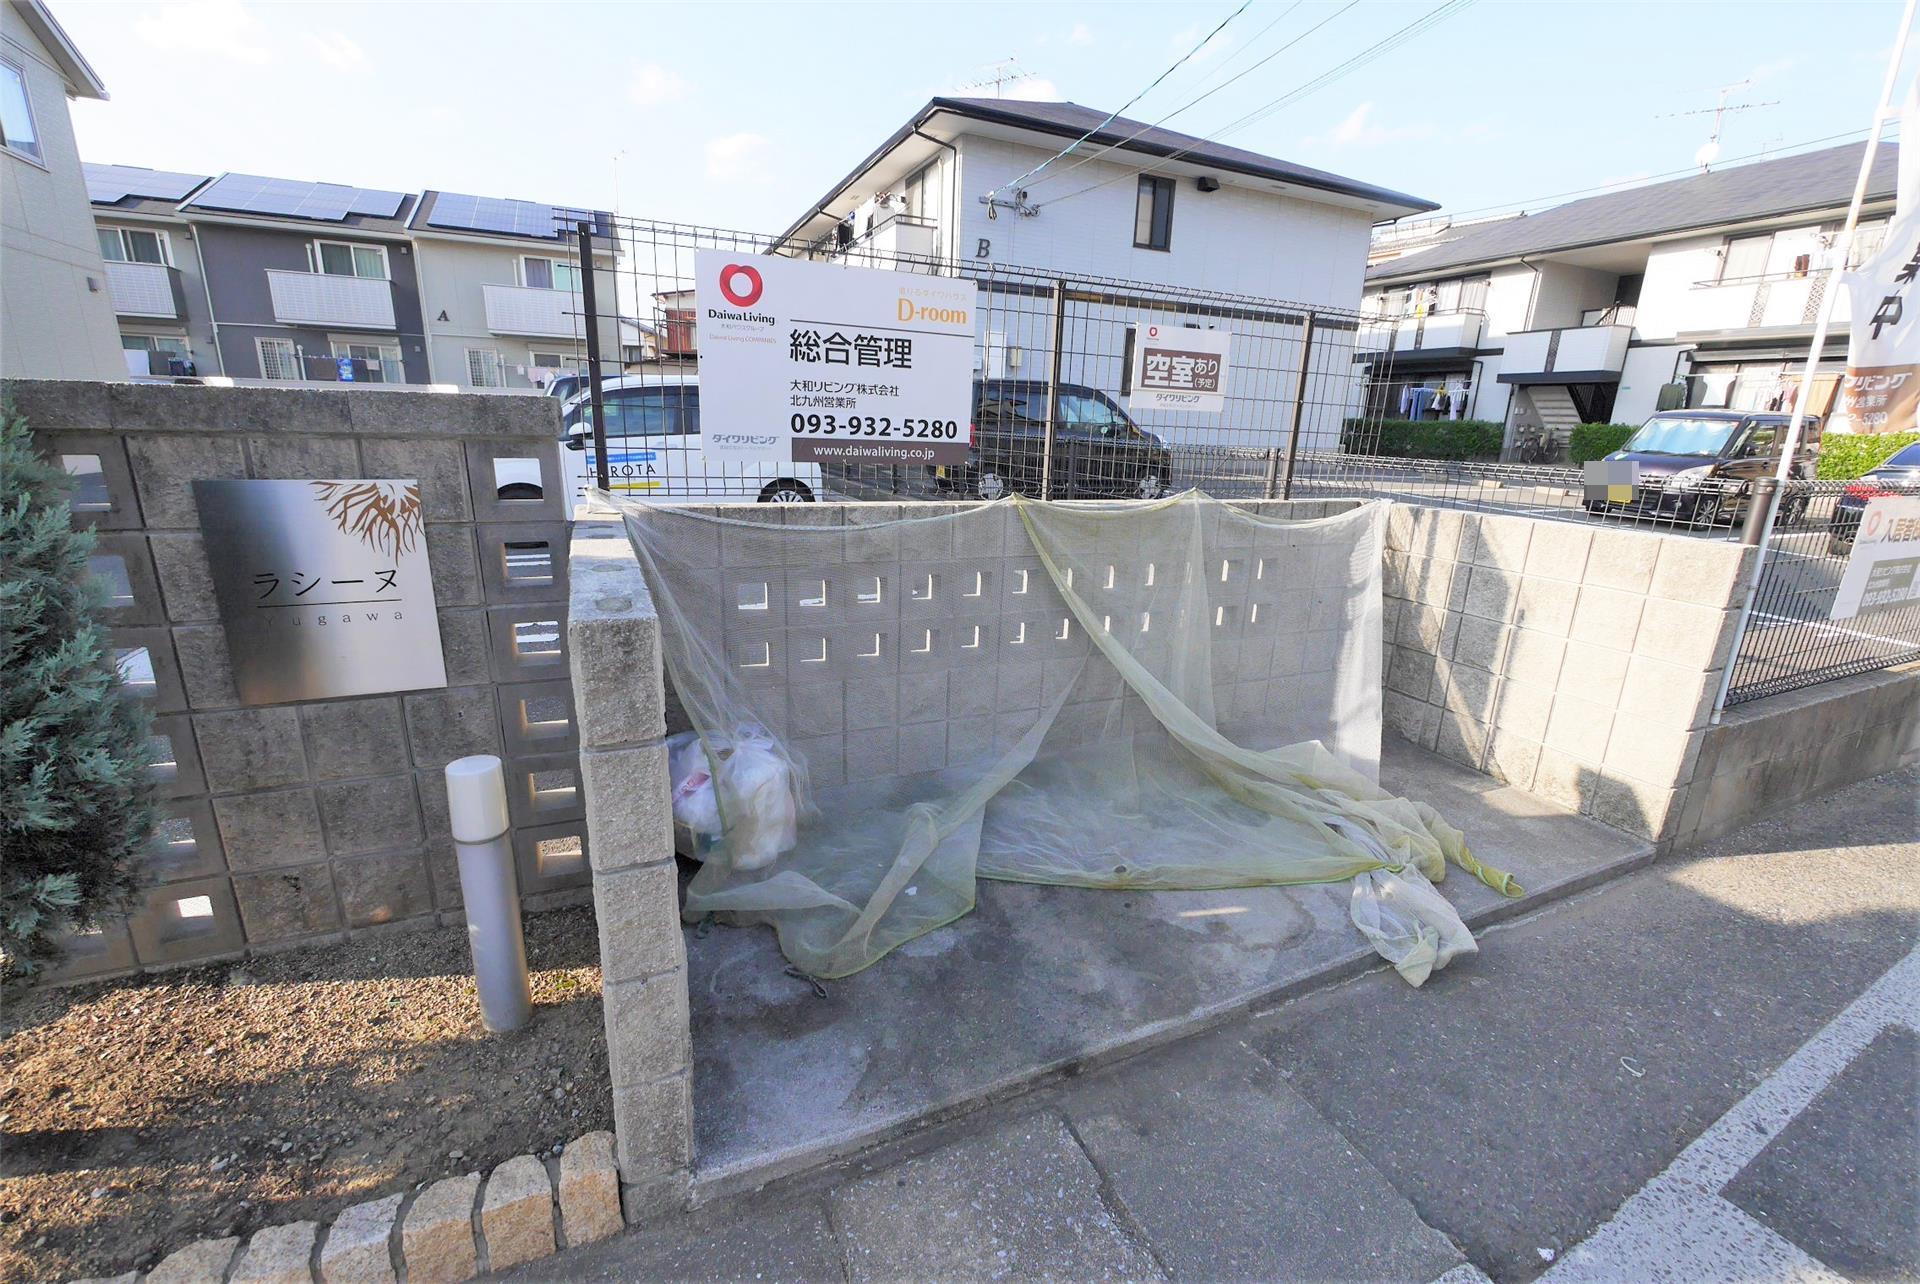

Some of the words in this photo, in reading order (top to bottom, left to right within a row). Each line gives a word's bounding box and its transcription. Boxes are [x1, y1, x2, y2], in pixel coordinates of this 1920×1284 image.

[975, 238, 991, 258] B
[437, 309, 450, 322] A
[897, 297, 967, 325] D-room
[789, 328, 912, 369] 総合管理
[790, 379, 900, 397] 大和リビング株式会社
[790, 396, 857, 409] 北九州営業所
[1155, 393, 1201, 404] ダイワリビング
[790, 413, 958, 439] 093-932-5280
[712, 433, 780, 445] ダイワリビング
[813, 445, 936, 461] www.daiwaliving.co.jp
[589, 463, 657, 478] HROTA
[254, 569, 398, 600] ラシーヌ
